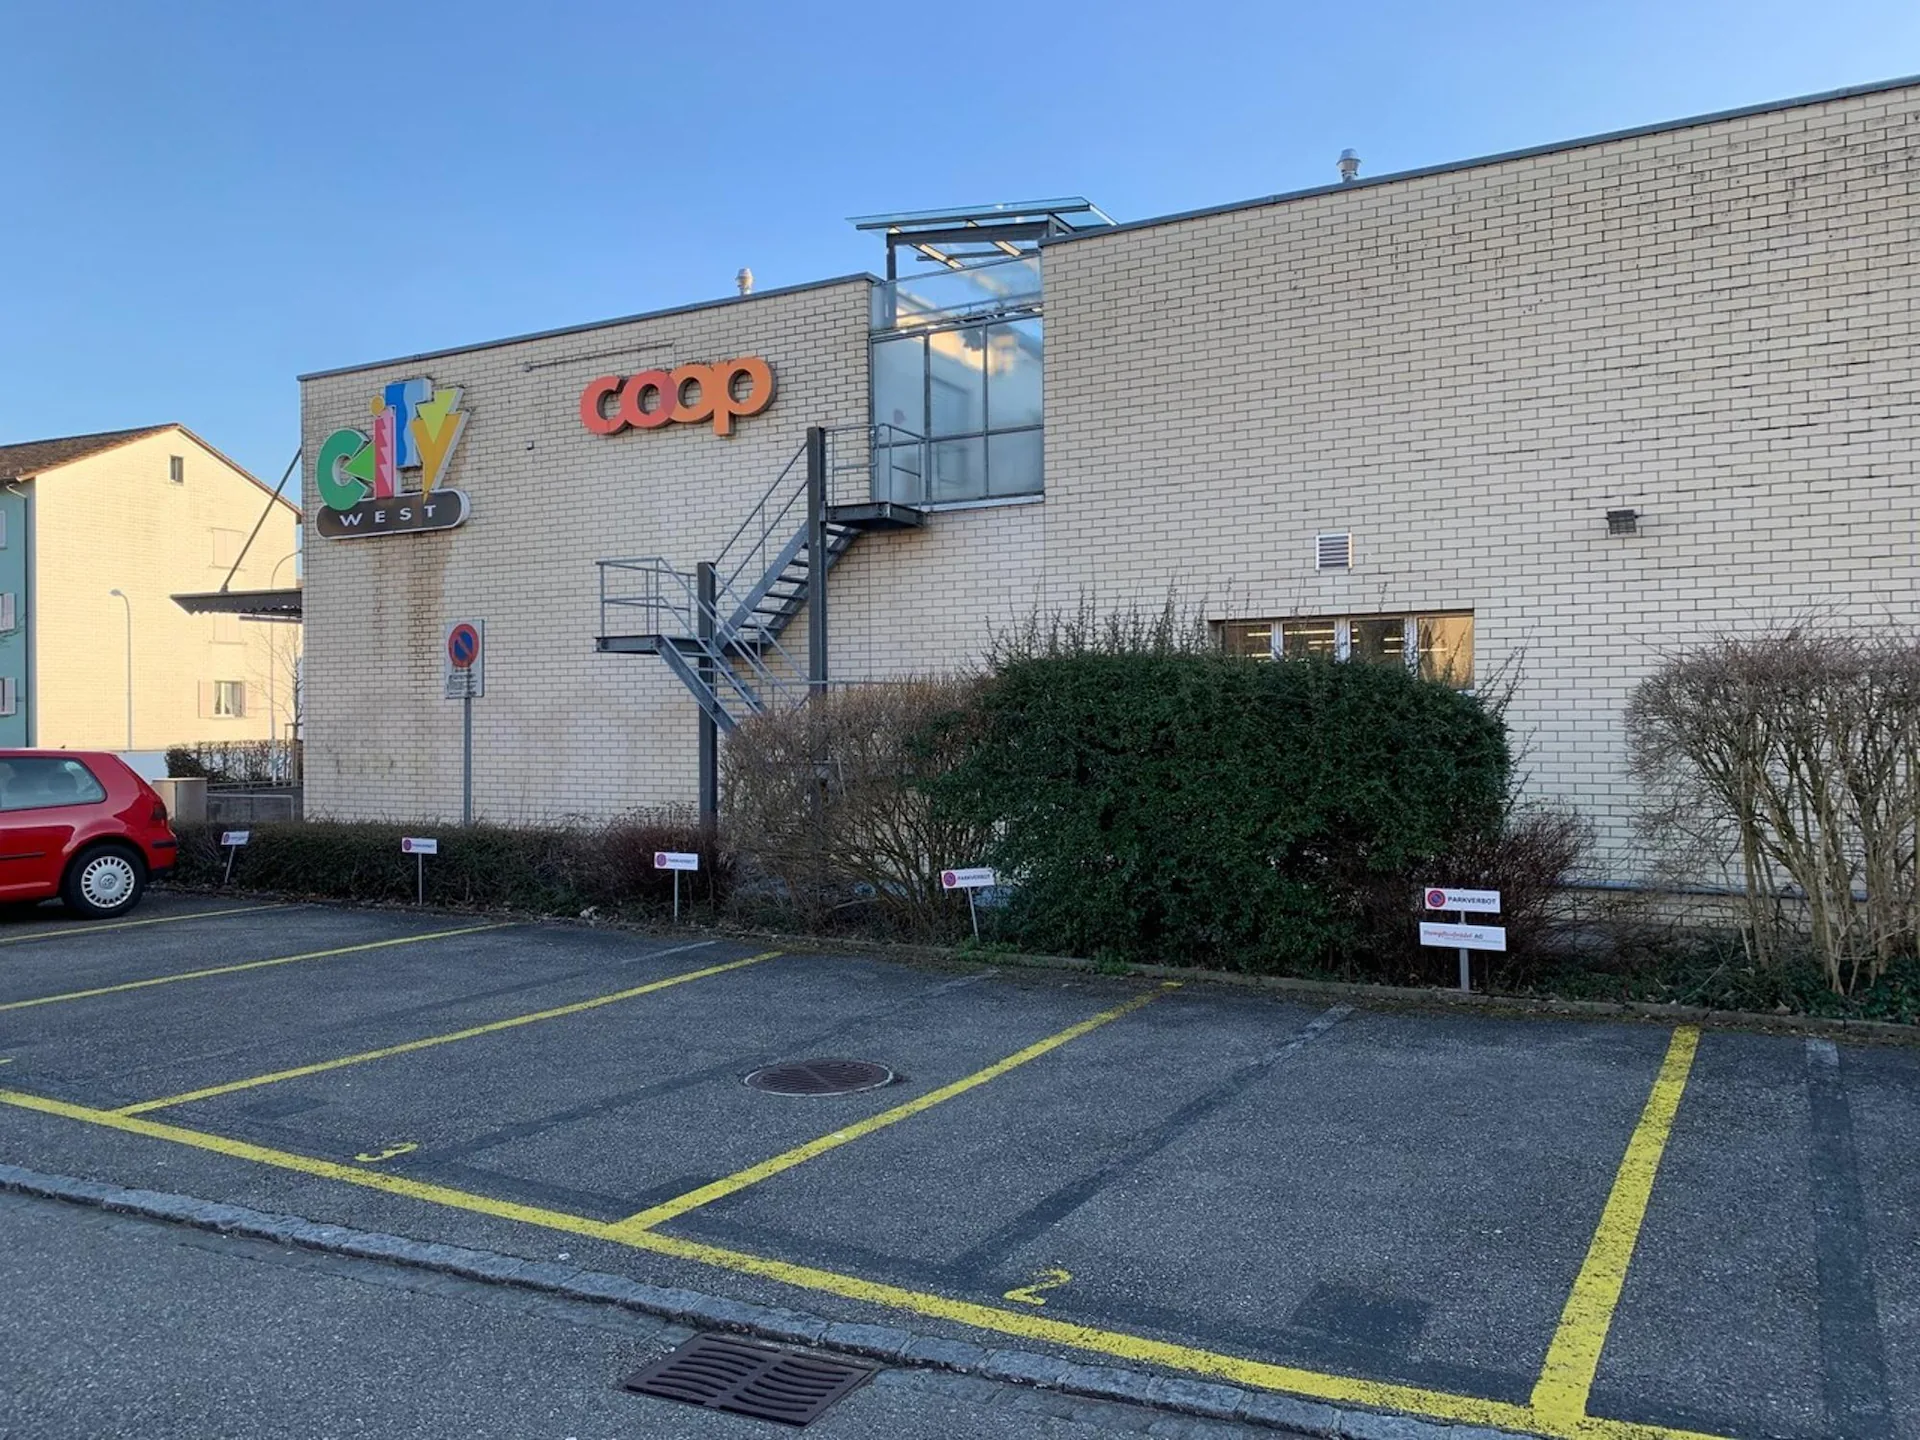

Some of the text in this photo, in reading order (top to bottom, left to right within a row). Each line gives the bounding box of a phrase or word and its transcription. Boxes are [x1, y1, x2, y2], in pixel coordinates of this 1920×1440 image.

[580, 356, 777, 436] coop
[339, 504, 437, 527] WEST
[1447, 895, 1497, 906] PARKVERBOT
[1003, 1269, 1072, 1306] 2
